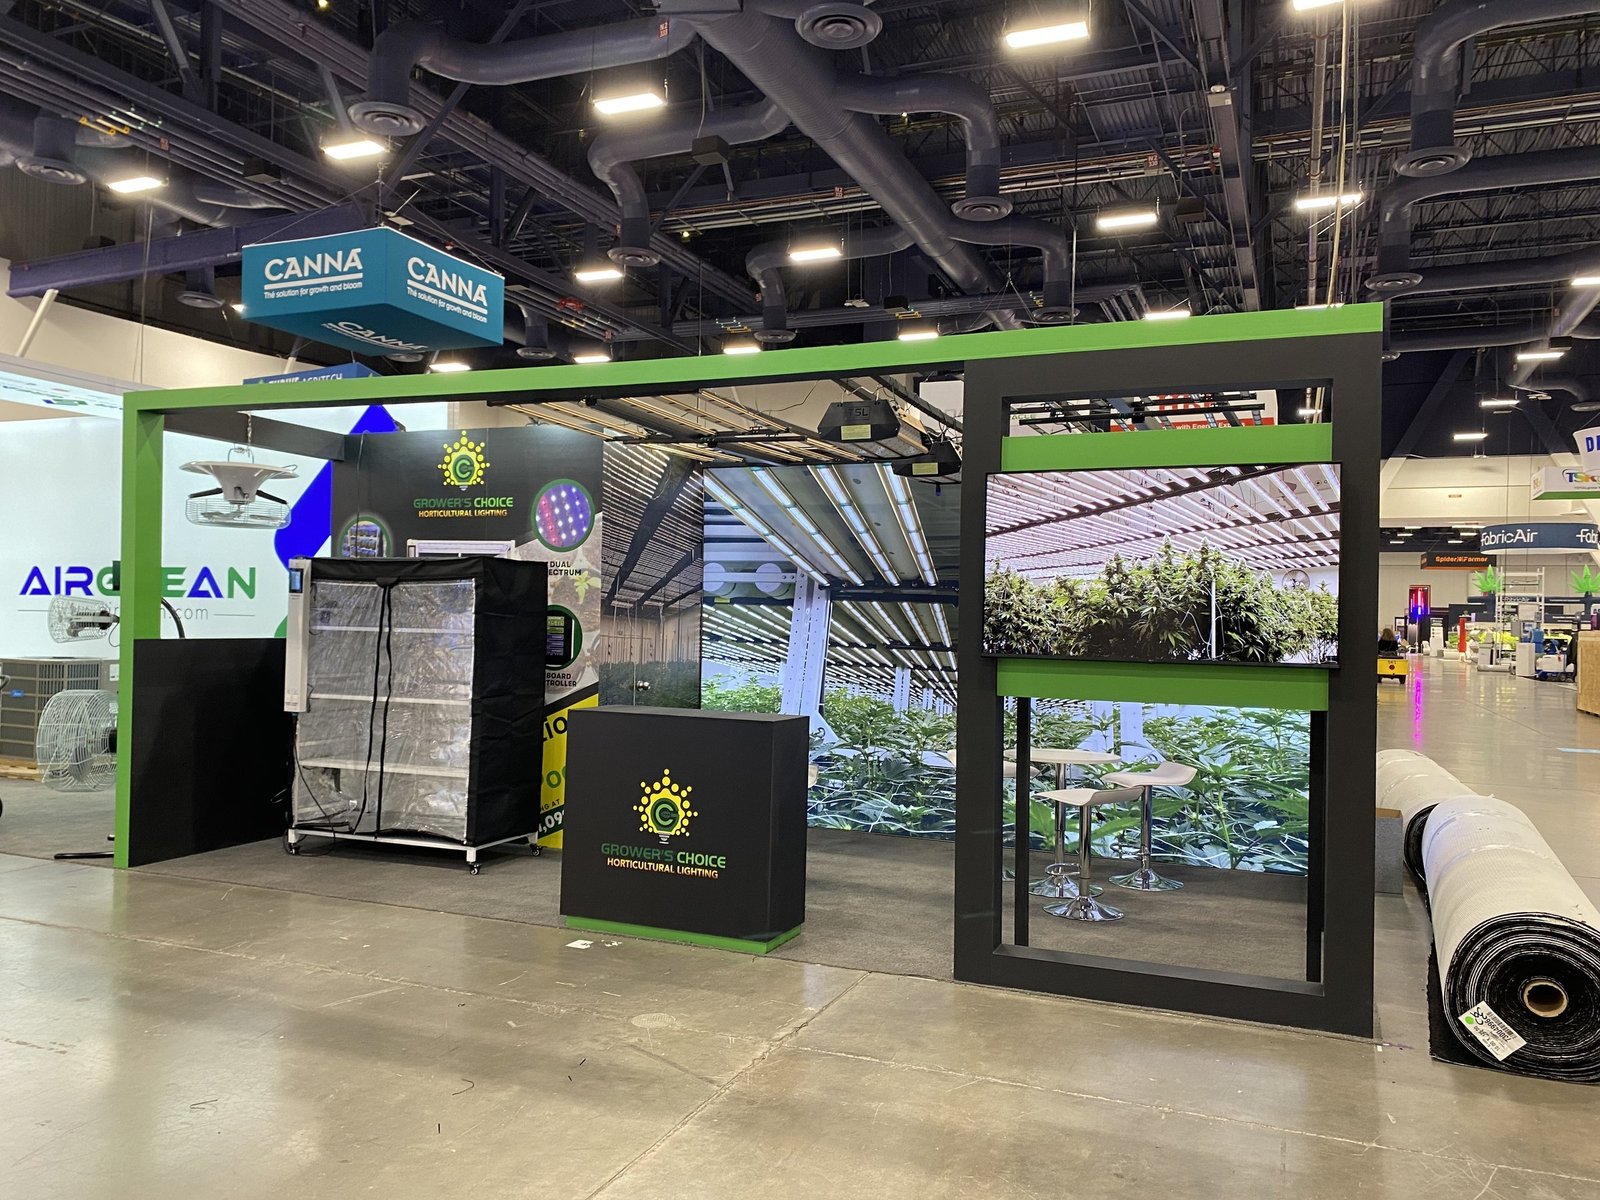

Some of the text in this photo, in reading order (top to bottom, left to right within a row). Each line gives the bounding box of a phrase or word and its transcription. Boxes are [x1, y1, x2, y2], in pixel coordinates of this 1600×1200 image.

[265, 248, 363, 281] CANNA
[276, 289, 299, 298] solution
[300, 287, 308, 297] for
[309, 285, 329, 296] growth
[330, 283, 342, 292] and
[342, 281, 362, 290] bloom
[407, 256, 488, 307] CANNA
[417, 291, 438, 305] solution
[446, 302, 462, 314] growth
[462, 309, 472, 318] and
[472, 311, 487, 323] bloom
[413, 497, 513, 508] GROWER'S CHOICE
[418, 509, 508, 518] HORTICULTURAL LIGHTING
[1480, 528, 1538, 547] FabricAir
[19, 565, 256, 599] AIRCEAN
[548, 568, 582, 576] ECTRUM
[545, 679, 577, 687] TROLLER
[601, 843, 726, 868] GROWER'S CHOICE
[607, 857, 719, 879] HORTICULTURAL LIGHTING
